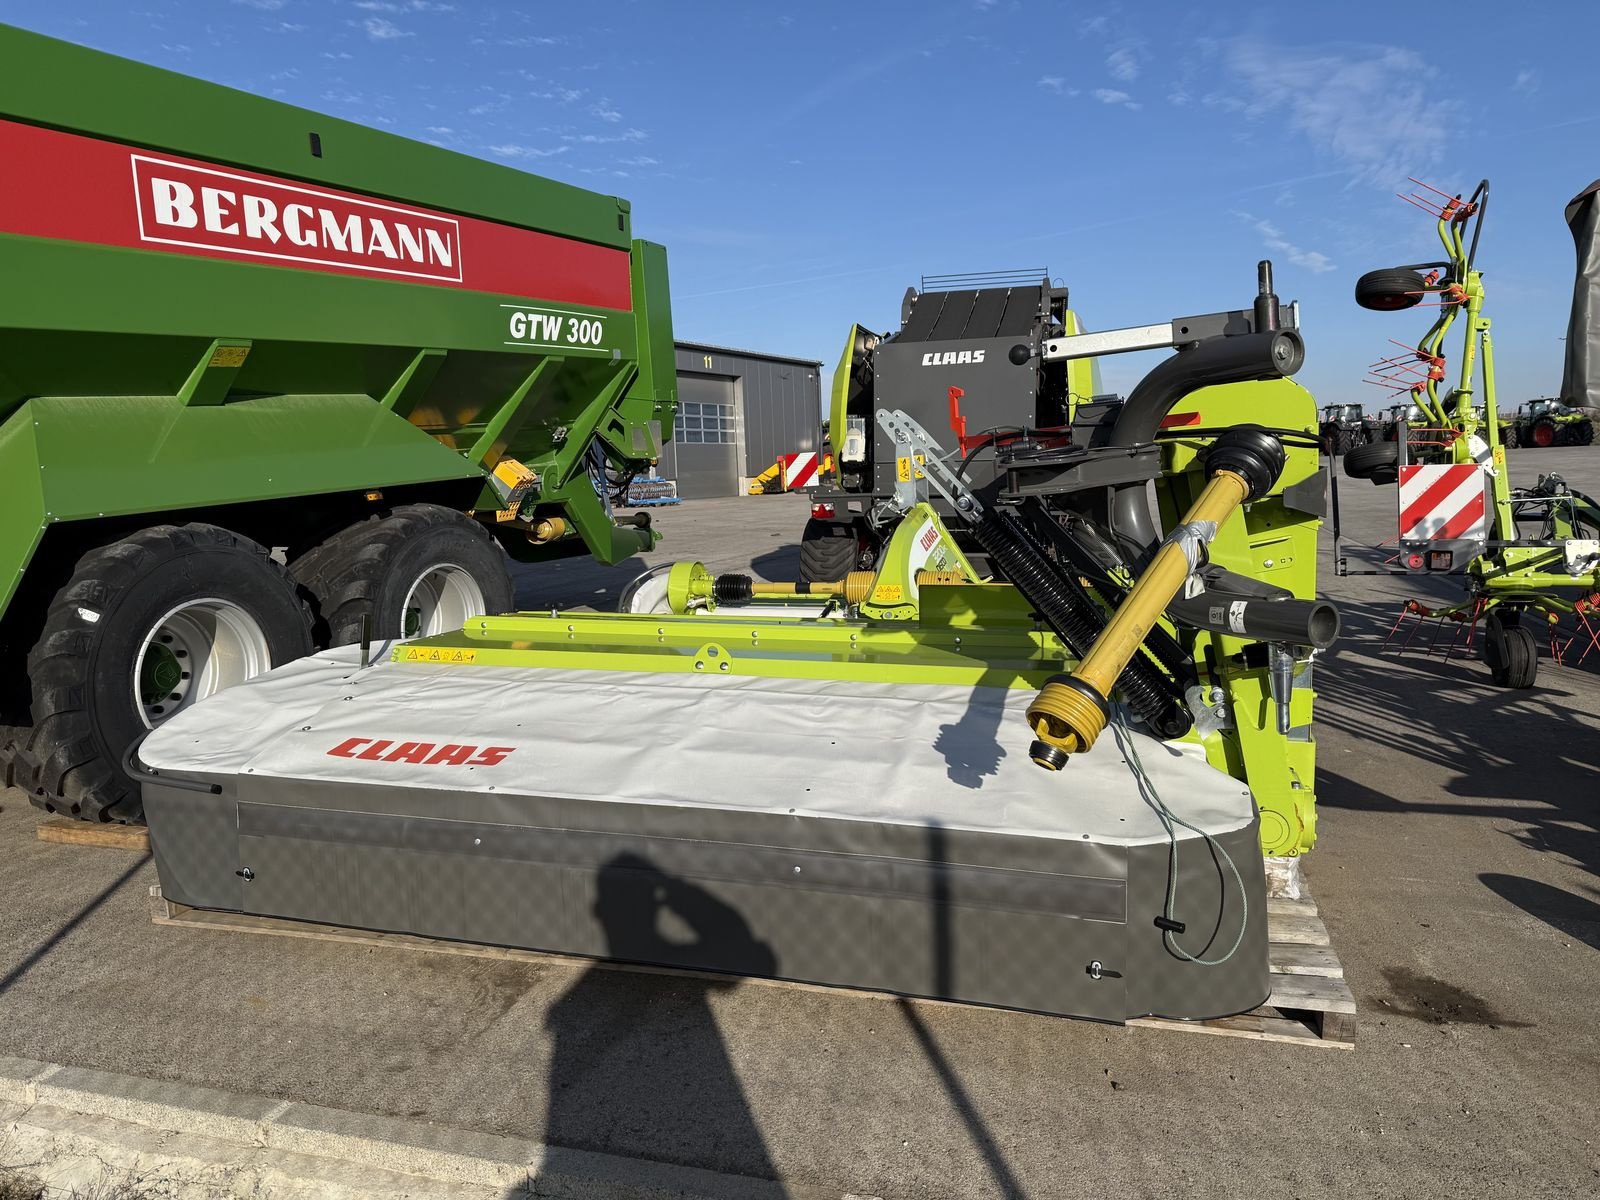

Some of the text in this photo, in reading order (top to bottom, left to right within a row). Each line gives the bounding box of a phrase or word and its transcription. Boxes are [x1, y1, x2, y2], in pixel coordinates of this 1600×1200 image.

[151, 177, 452, 267] BERGMANN
[509, 311, 603, 345] GTW 300
[703, 355, 713, 369] 11
[921, 350, 985, 366] CLAAS
[920, 526, 939, 552] CLAAS
[326, 737, 517, 766] CLAAS
